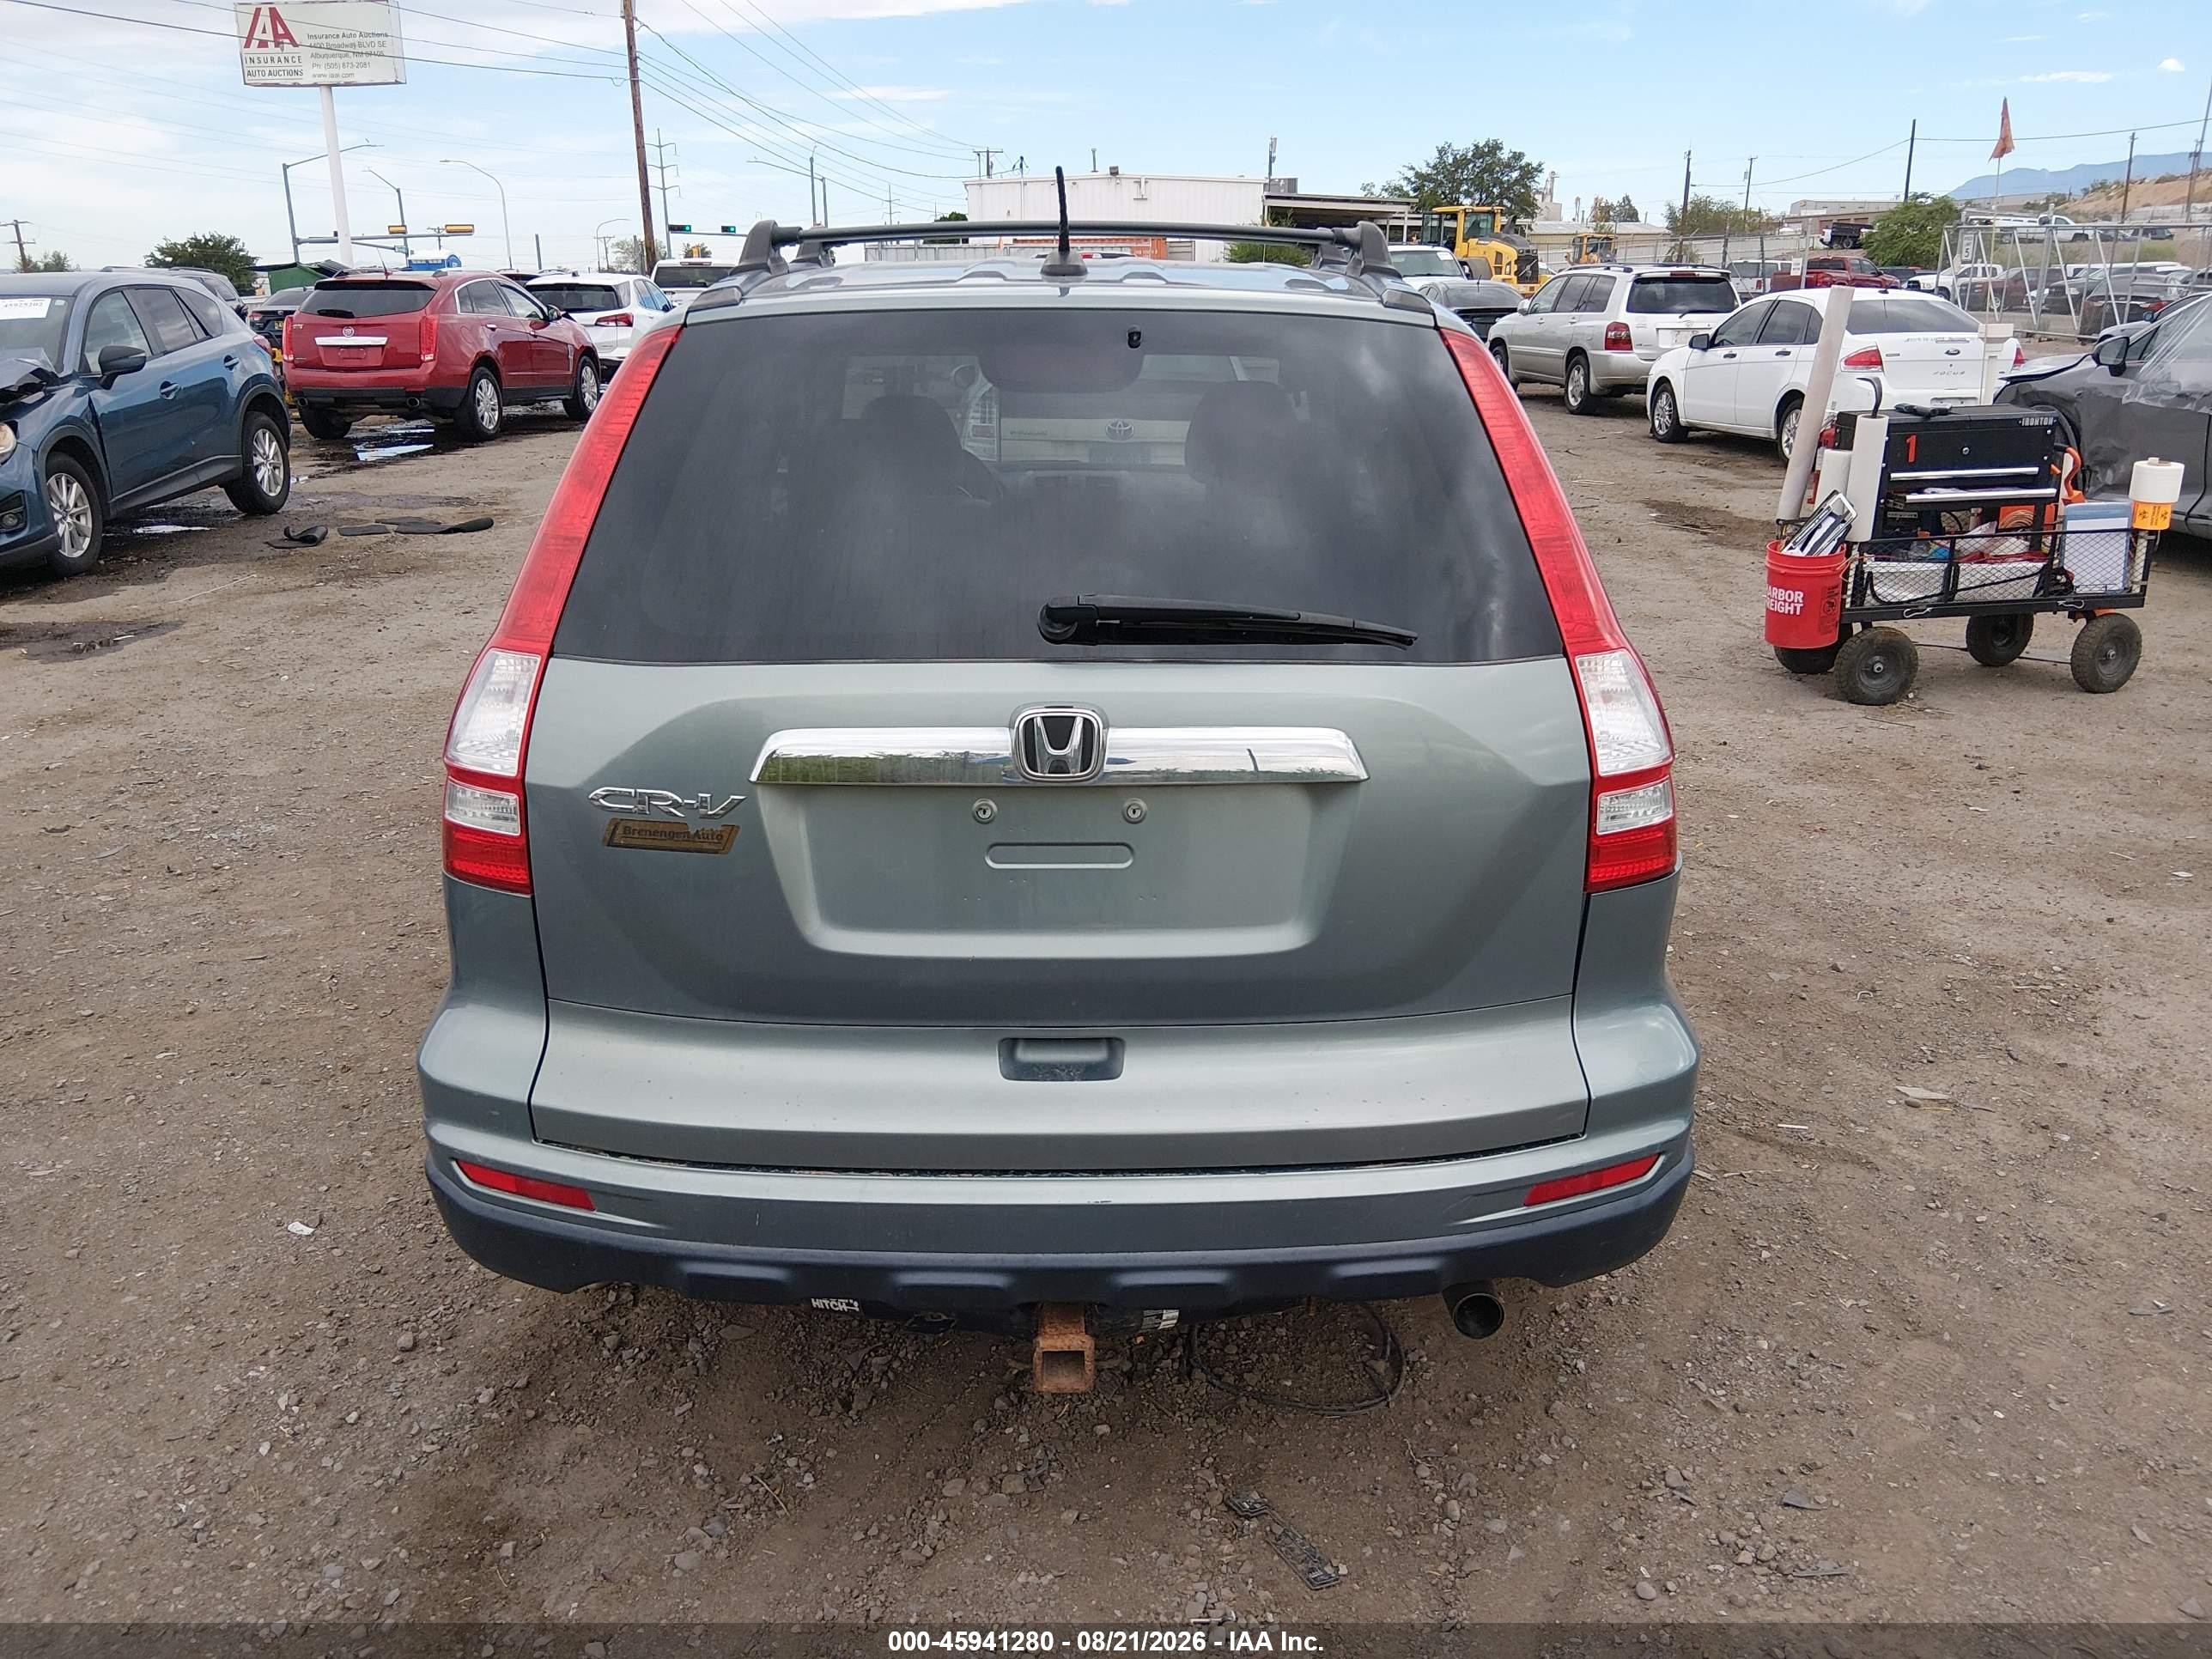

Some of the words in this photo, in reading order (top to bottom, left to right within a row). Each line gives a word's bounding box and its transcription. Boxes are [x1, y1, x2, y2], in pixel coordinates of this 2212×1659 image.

[245, 55, 302, 64] INSURANCE
[267, 69, 304, 77] AUCTIONS
[1964, 247, 1970, 258] 5
[1905, 434, 1917, 464] 1
[1766, 585, 1804, 604] ARBOR
[1765, 598, 1804, 617] REIGHT
[588, 786, 747, 819] CR-V
[692, 829, 724, 842] Auto
[811, 1297, 848, 1312] HITCH
